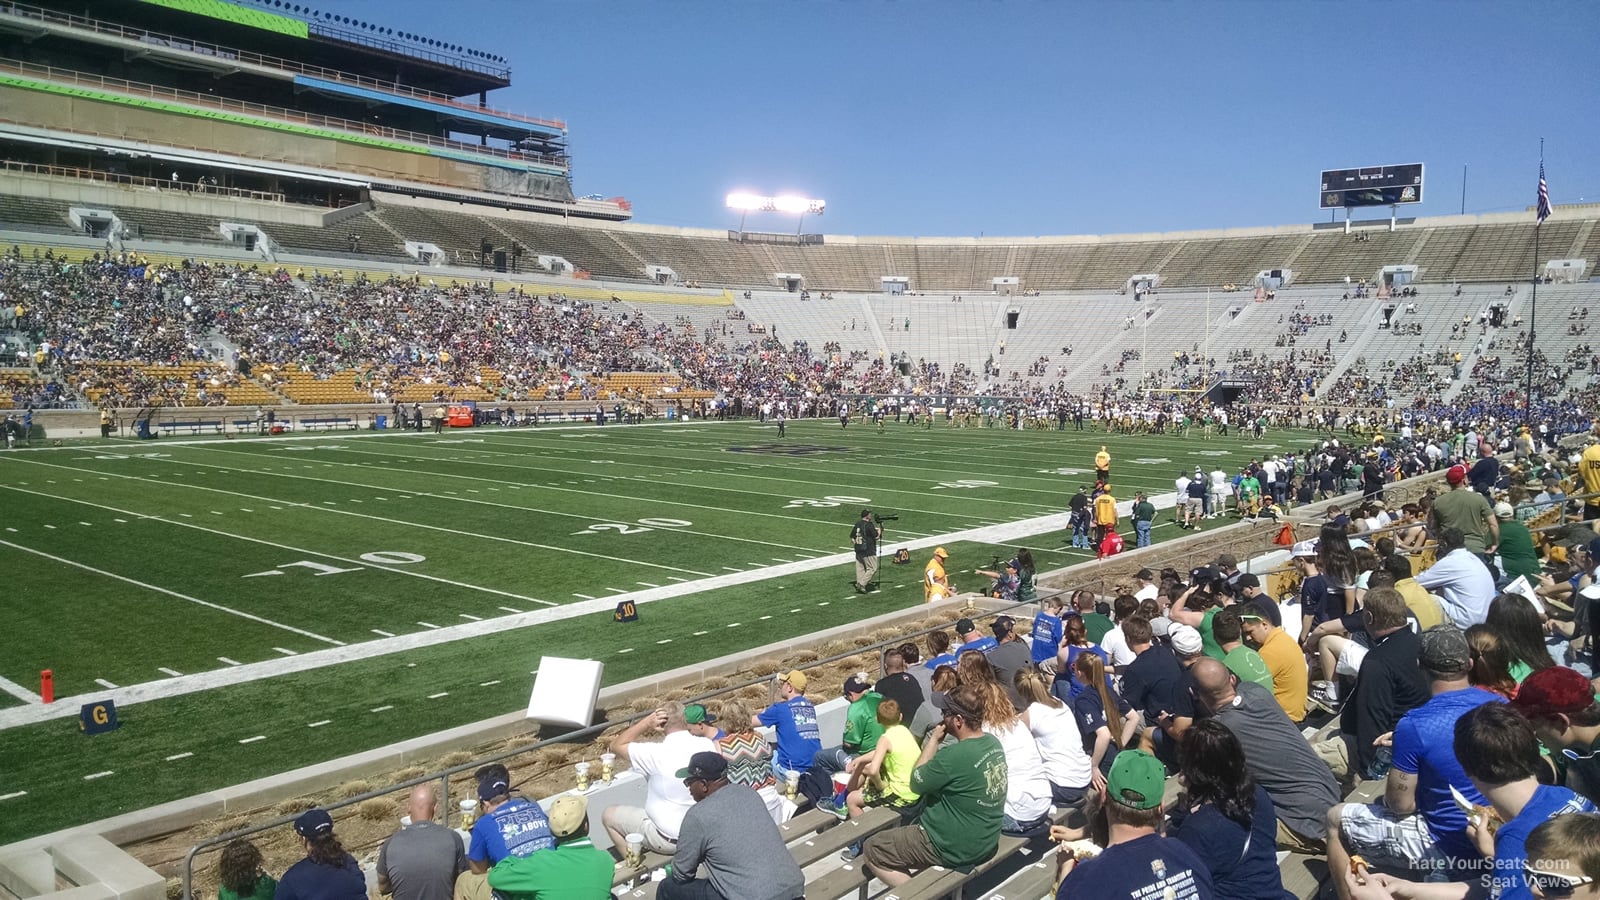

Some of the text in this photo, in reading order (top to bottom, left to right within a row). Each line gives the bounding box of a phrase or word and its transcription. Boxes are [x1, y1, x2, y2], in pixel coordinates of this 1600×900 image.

[789, 495, 872, 508] 30
[588, 518, 693, 535] 20
[275, 551, 427, 577] 10
[622, 602, 635, 617] 10
[92, 704, 109, 725] G
[521, 819, 548, 833] ABOVE
